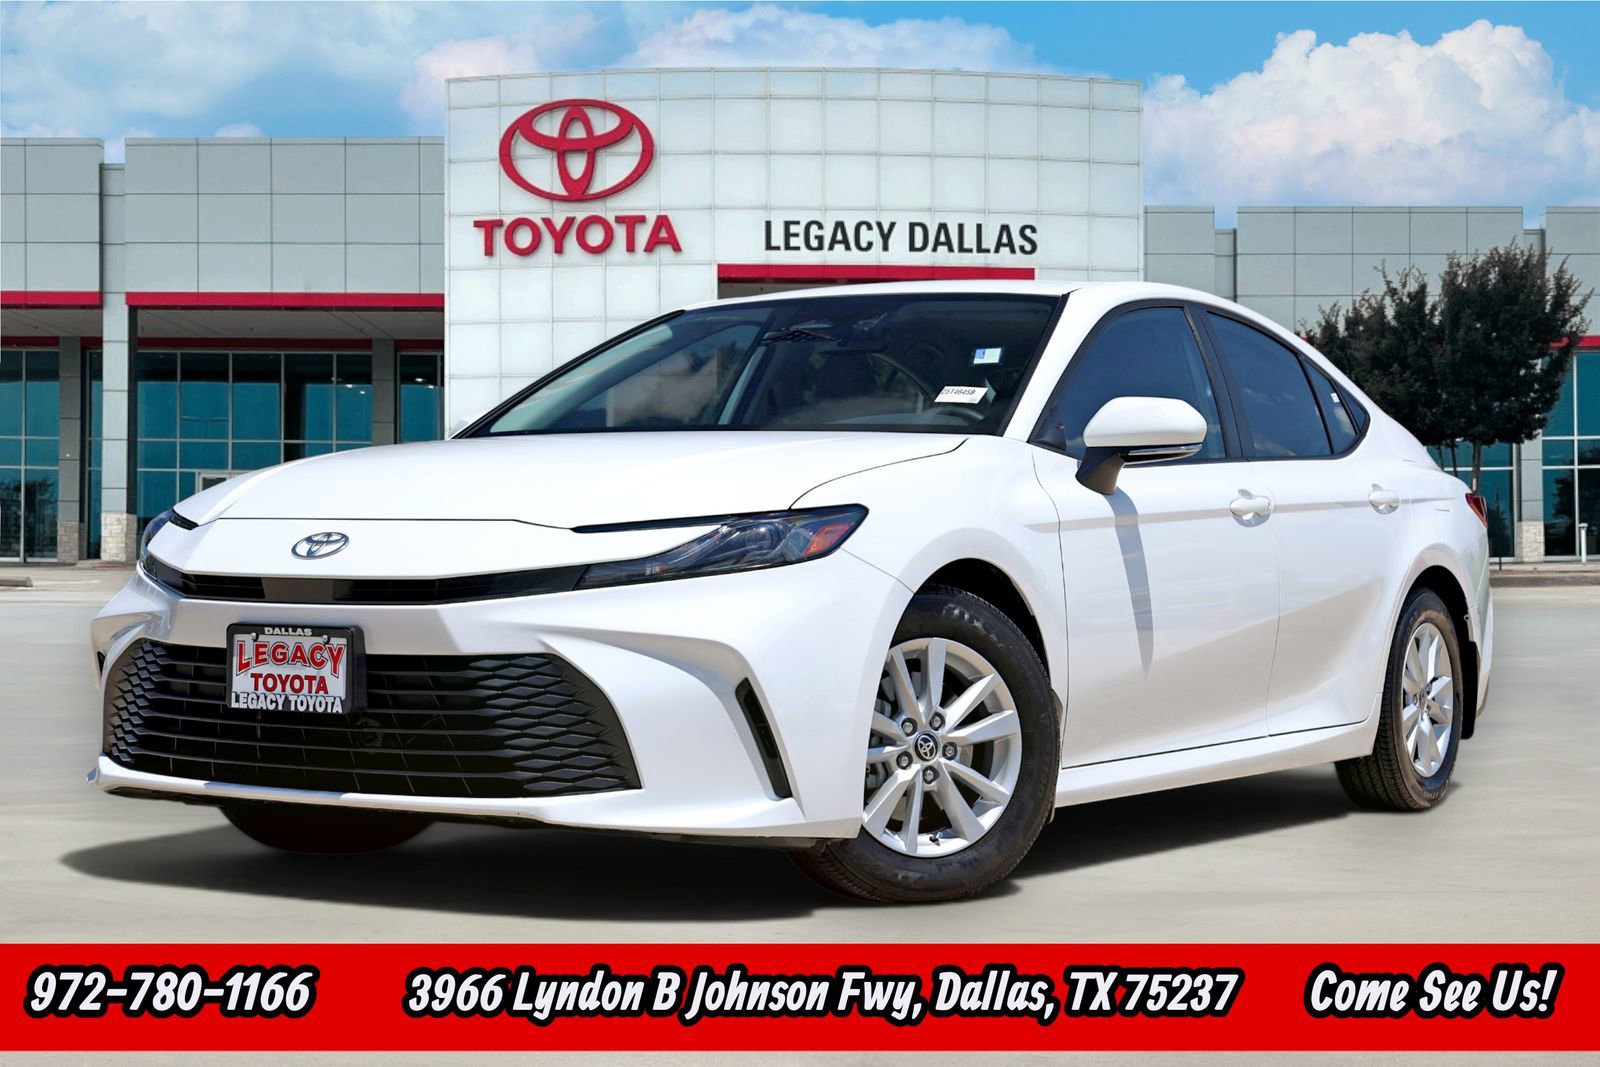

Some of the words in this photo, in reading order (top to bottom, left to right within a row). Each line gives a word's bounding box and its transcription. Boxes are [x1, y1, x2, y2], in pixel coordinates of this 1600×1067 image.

[473, 214, 682, 257] TOYOTA
[764, 220, 896, 253] LEGACY
[908, 222, 1039, 255] DALLAS
[264, 626, 313, 636] DALLAS
[236, 640, 347, 678] LEGACY
[250, 672, 329, 695] TOYOTA
[230, 691, 288, 711] LEGACY
[288, 693, 344, 714] TOYOTA
